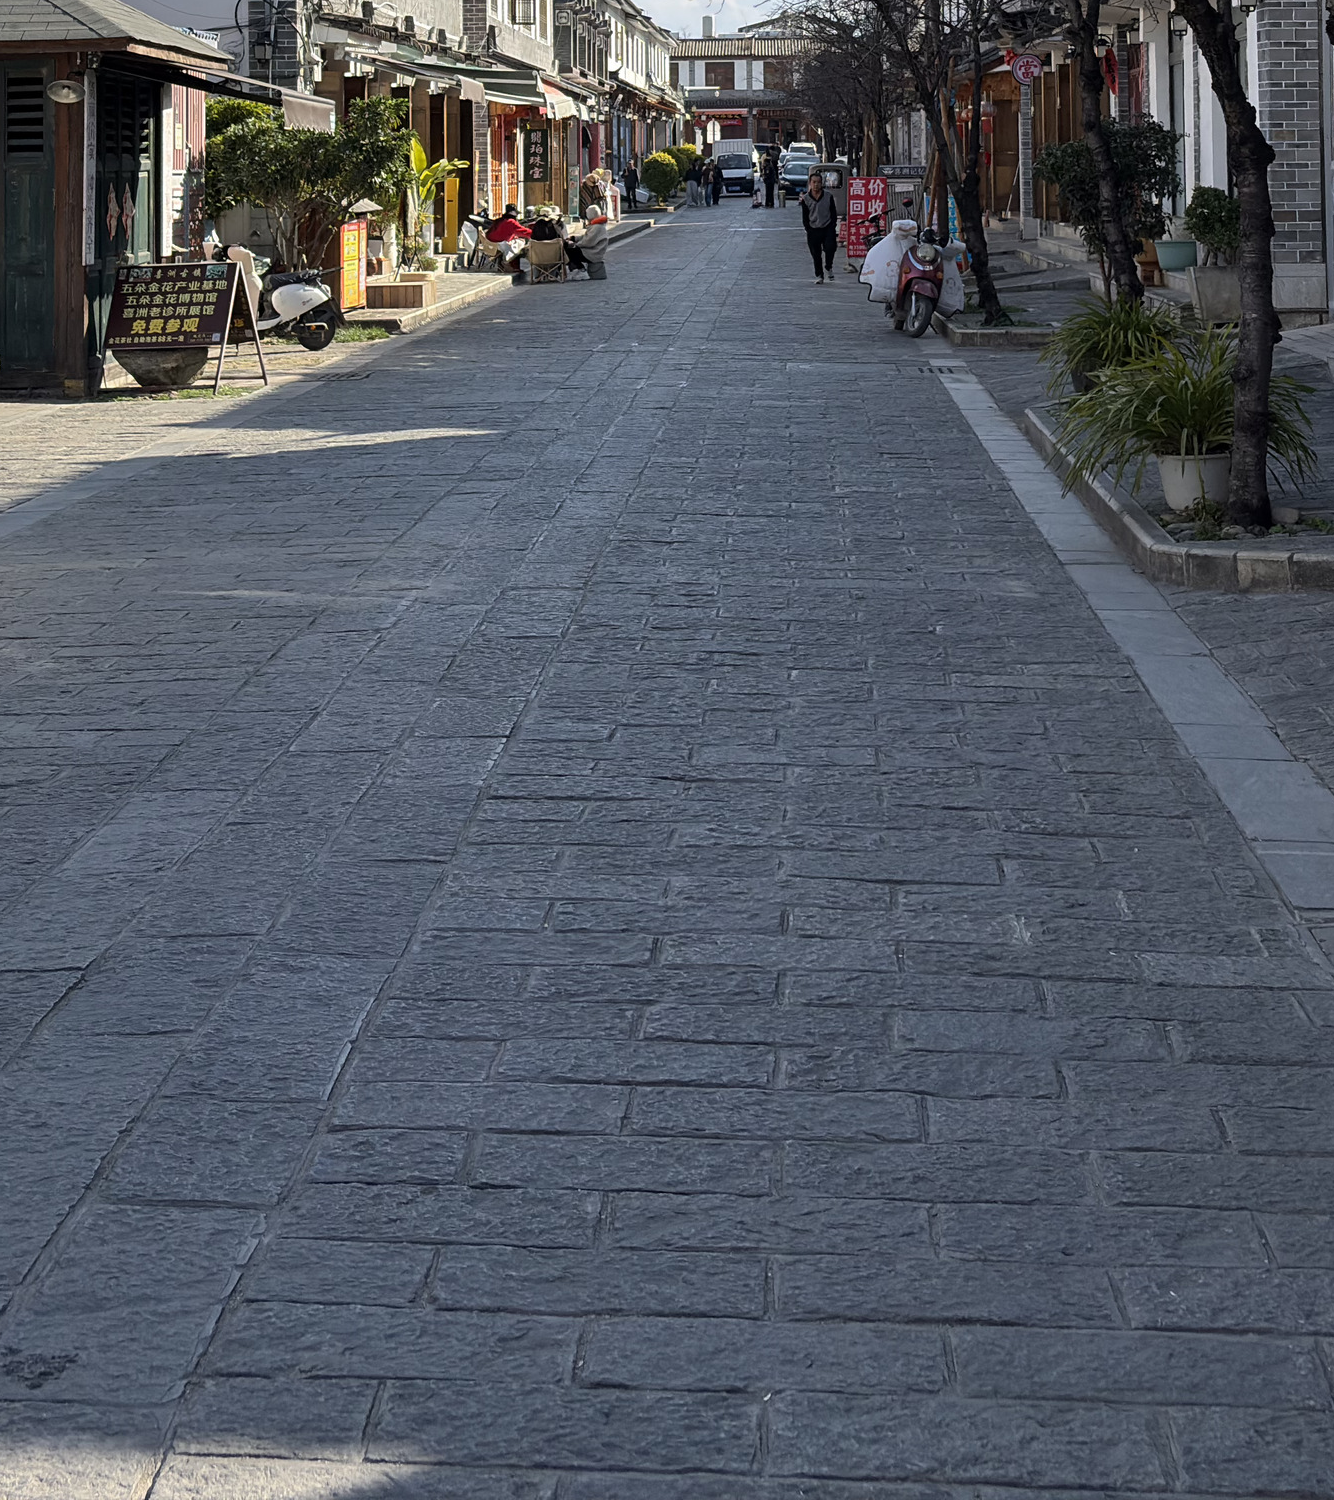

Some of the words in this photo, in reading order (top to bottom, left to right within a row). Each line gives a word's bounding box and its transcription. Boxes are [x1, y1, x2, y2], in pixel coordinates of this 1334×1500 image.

[850, 179, 885, 196] 高价
[850, 199, 885, 216] 回收
[154, 267, 202, 280] 喜洲古镇
[120, 279, 228, 294] 五朵金花产业基地
[125, 292, 219, 306] 五朵金花博物馆
[122, 304, 215, 318] 喜洲老诊所展馆
[130, 318, 200, 334] 免费参观
